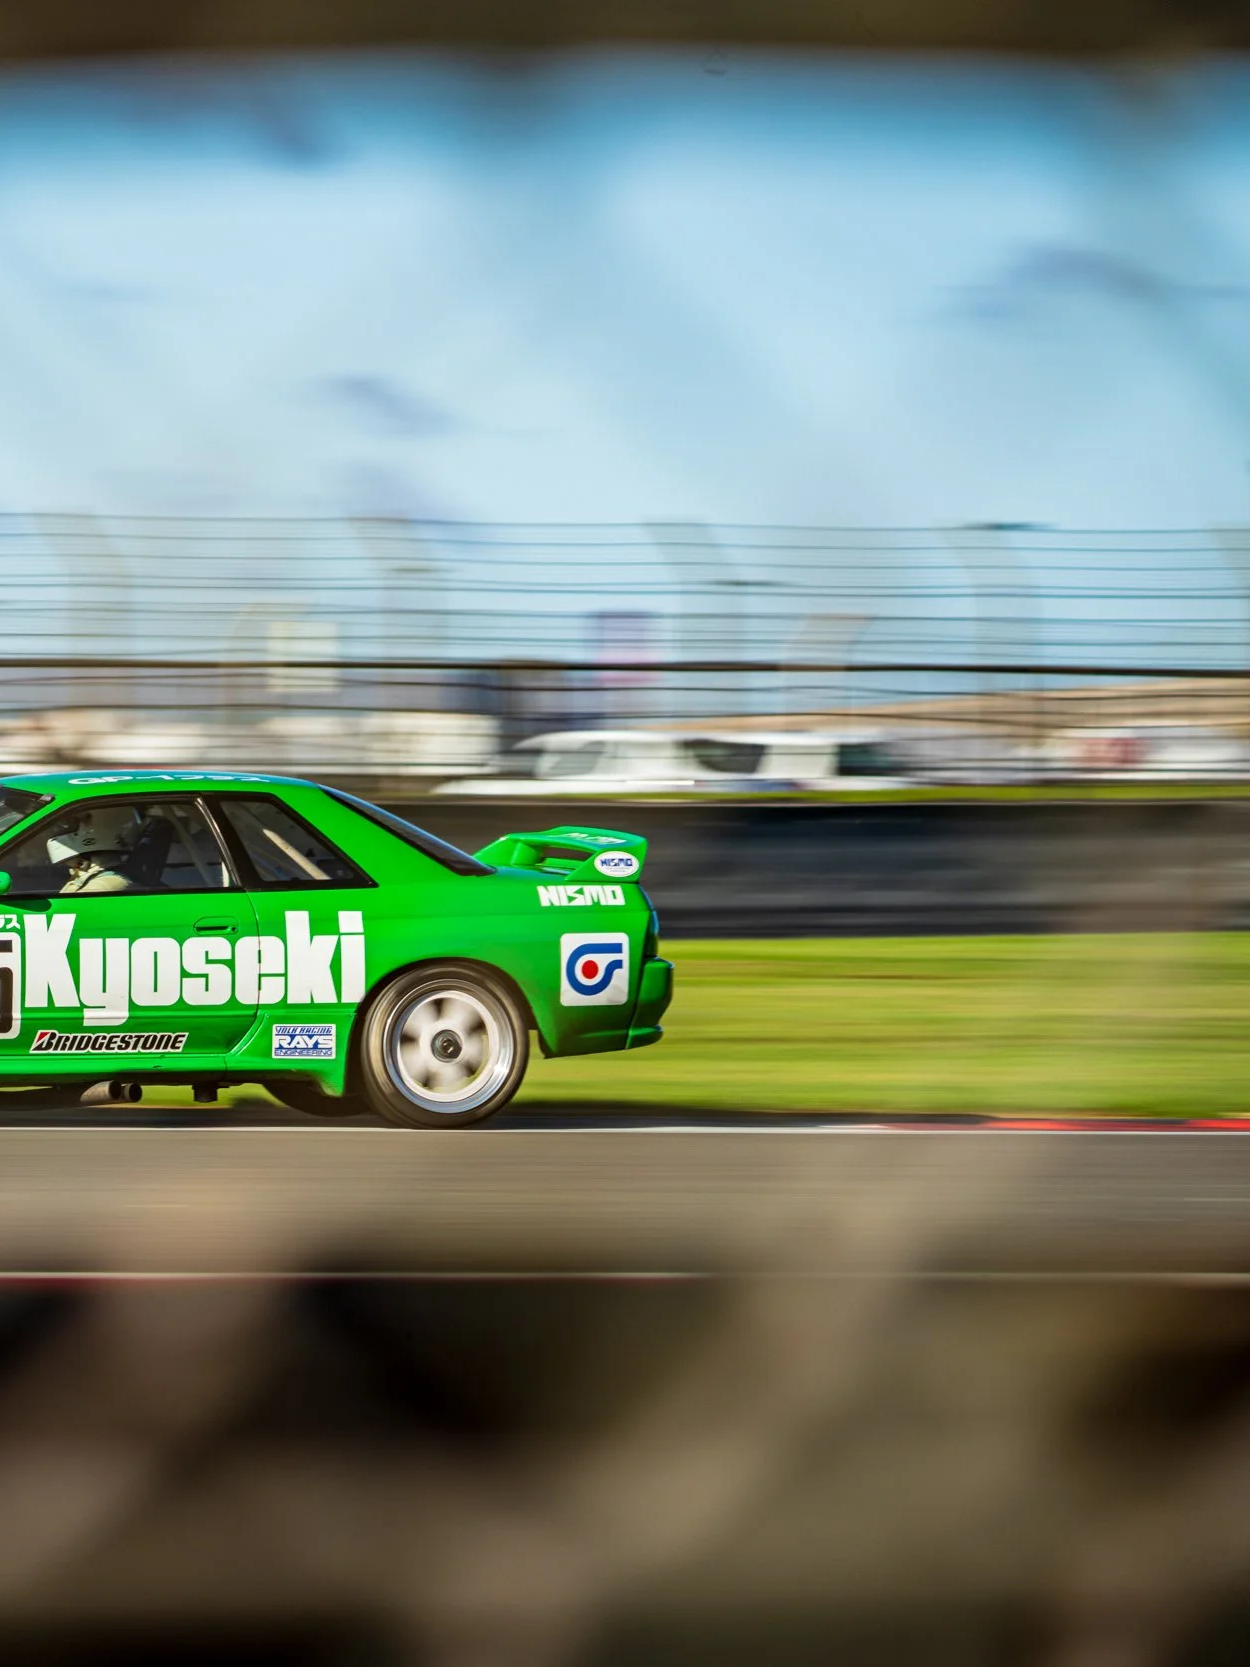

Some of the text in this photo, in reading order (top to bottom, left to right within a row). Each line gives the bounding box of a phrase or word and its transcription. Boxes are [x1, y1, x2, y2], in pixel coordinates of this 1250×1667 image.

[600, 858, 633, 867] NISMO
[537, 885, 625, 906] NISMO
[24, 911, 366, 1026] Kyoseki
[35, 1031, 186, 1051] BRIDGESTONE
[275, 1035, 333, 1048] RAYS
